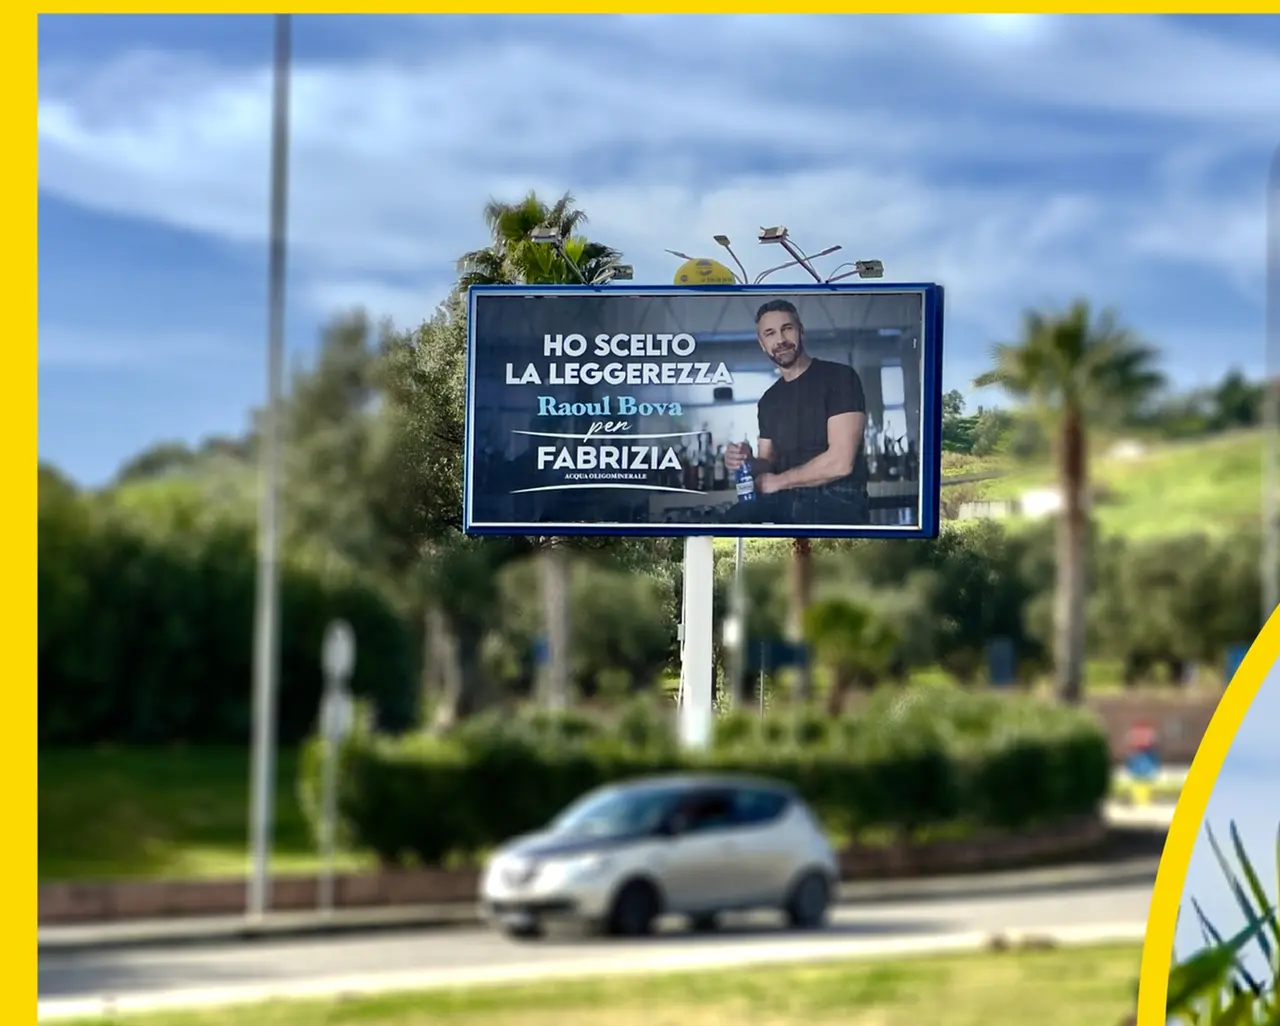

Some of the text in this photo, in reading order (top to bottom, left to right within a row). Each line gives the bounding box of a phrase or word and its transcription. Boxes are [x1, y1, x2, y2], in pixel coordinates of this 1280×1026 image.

[543, 333, 696, 357] HO SCELTO
[506, 362, 733, 385] LA LEGGEREZZA
[537, 395, 683, 417] Raoul Bova
[583, 418, 633, 442] per
[537, 445, 682, 470] FABRIZIA
